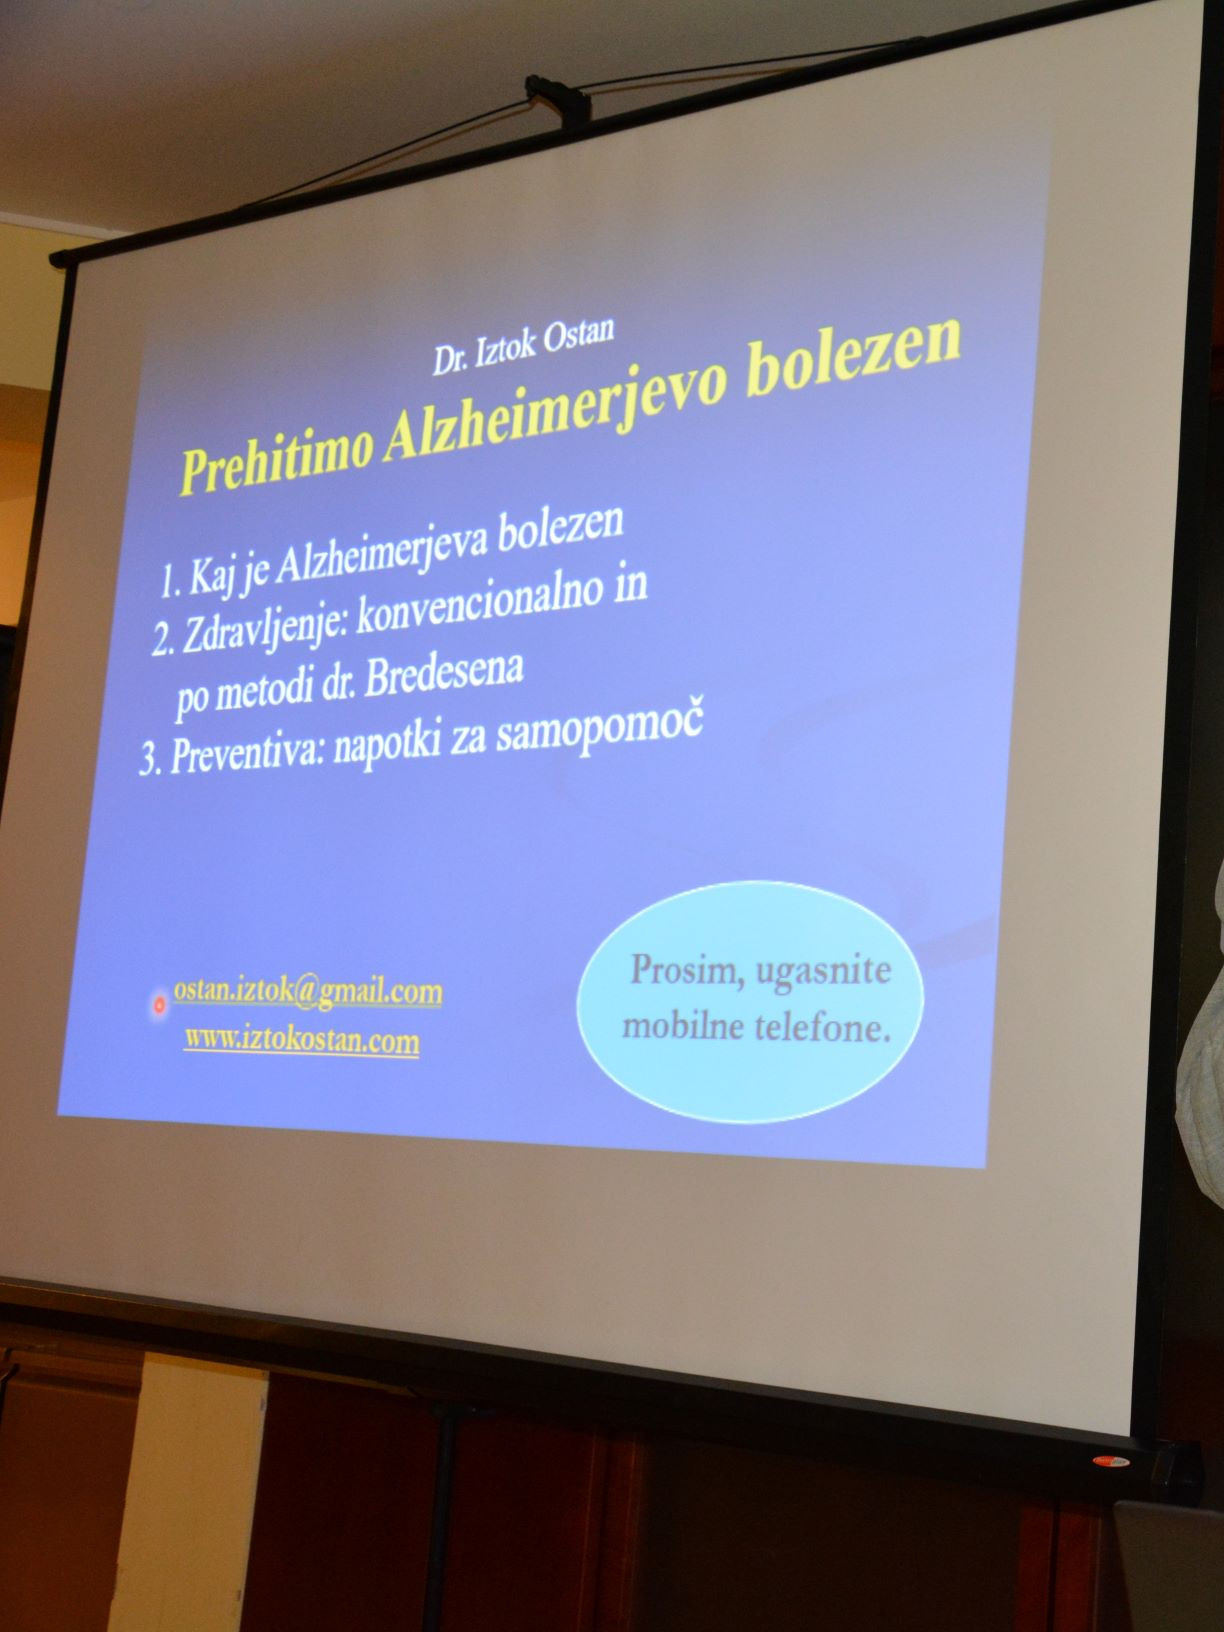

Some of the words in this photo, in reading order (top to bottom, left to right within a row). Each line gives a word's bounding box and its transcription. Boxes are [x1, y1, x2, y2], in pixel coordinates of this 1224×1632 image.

[432, 344, 470, 376] Dr.
[475, 325, 537, 368] Iztok
[543, 318, 615, 352] Ostan
[179, 427, 374, 497] Prehitimo
[382, 363, 727, 462] Alzheimerjevo
[747, 318, 961, 397] bolezen
[161, 563, 181, 598] 1.
[189, 552, 238, 602] Kaj
[238, 549, 270, 600] je
[275, 522, 488, 584] Alzheimerjeva
[498, 504, 624, 552] bolezen
[151, 620, 174, 656] 2.
[182, 600, 348, 656] Zdravljenje:
[356, 568, 603, 635] konvencionalno
[614, 559, 648, 603] in
[174, 683, 210, 725] po
[215, 661, 314, 711] metodi
[322, 661, 355, 700] dr.
[363, 650, 524, 698] Bredesena
[138, 740, 161, 776] 3.
[170, 728, 325, 774] Preventiva:
[333, 715, 442, 774] napotki
[450, 725, 487, 756] za
[496, 694, 704, 760] samopomoč
[173, 972, 443, 1012] ostan.iztok@gmail.com
[630, 953, 745, 992] Prosim,
[757, 952, 892, 996] ugasnite
[183, 1022, 420, 1059] www.iztokostan.com
[622, 1008, 745, 1040] mobilne
[755, 1009, 892, 1043] telefone.
